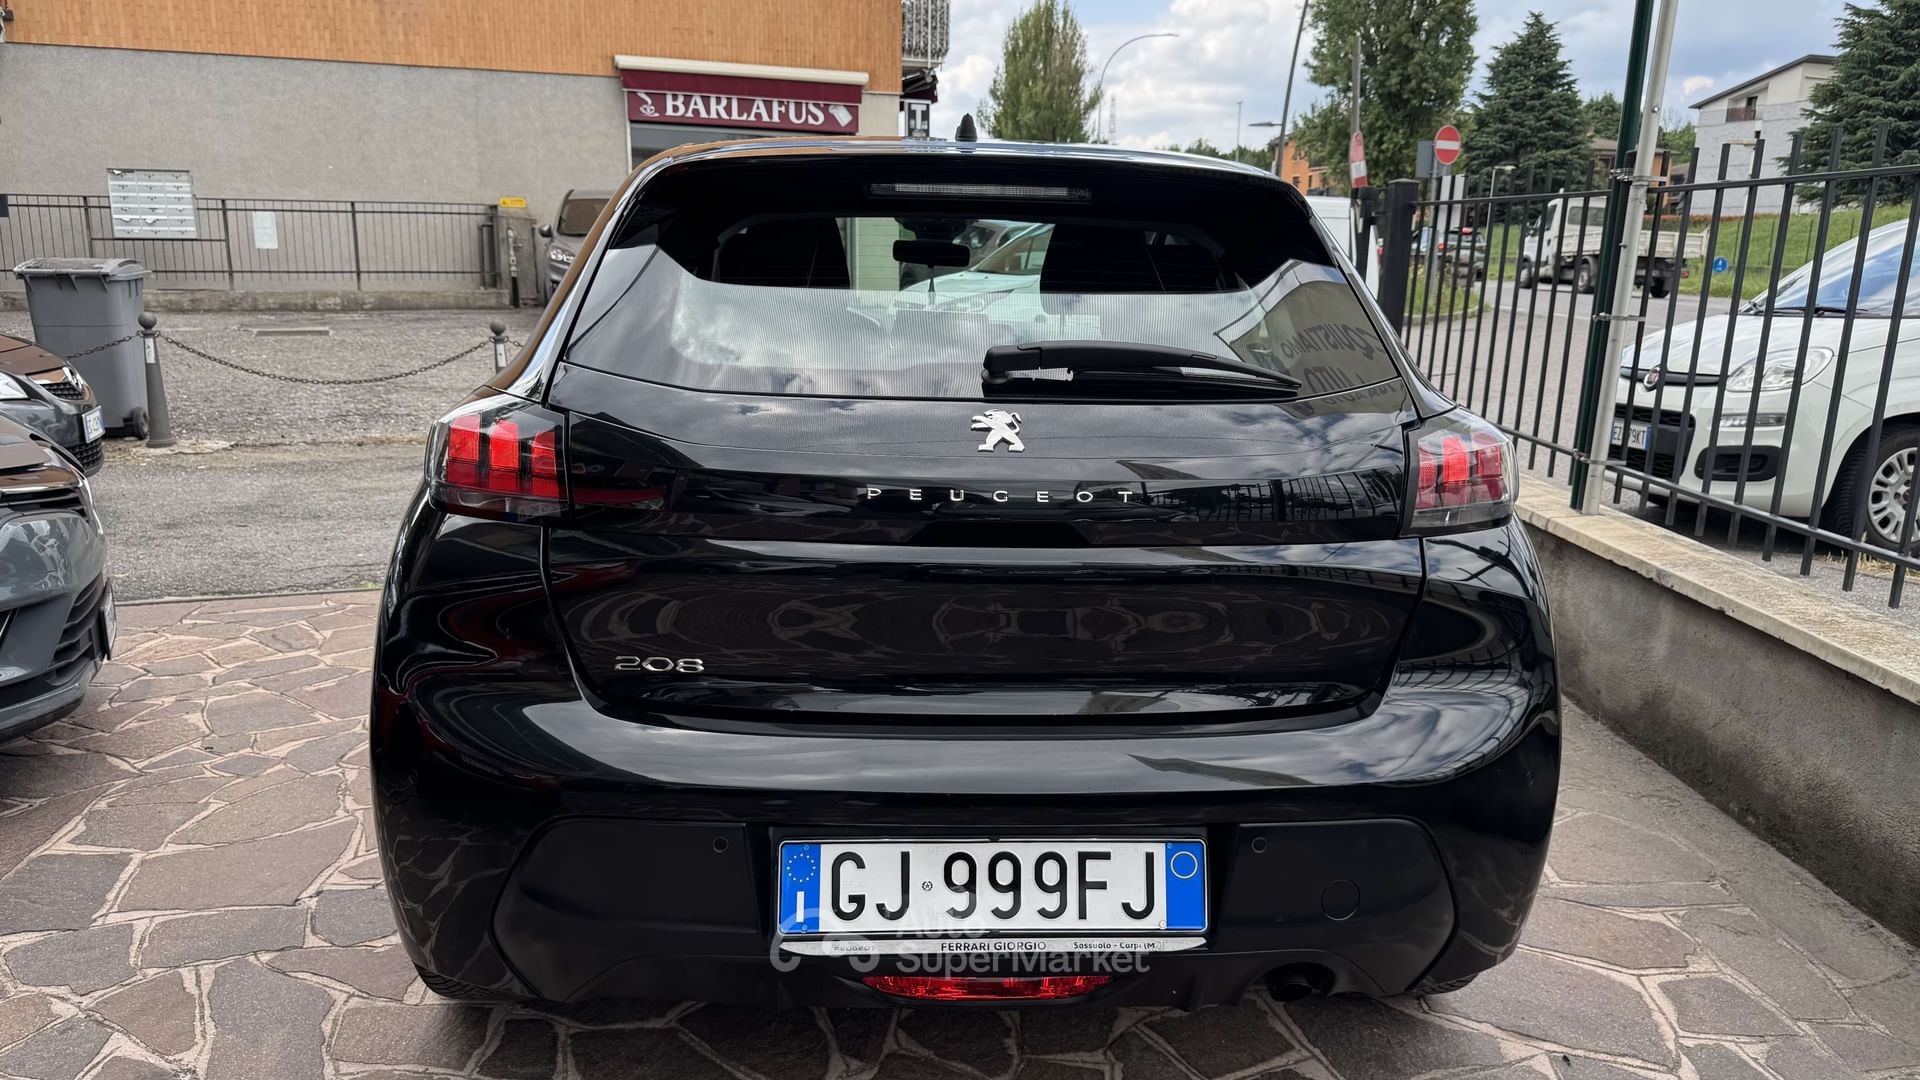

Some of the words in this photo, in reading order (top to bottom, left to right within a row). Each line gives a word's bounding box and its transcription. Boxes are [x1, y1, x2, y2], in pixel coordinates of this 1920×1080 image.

[665, 92, 826, 126] BARLAFUS
[1612, 425, 1646, 445] EZ9KT
[866, 487, 1133, 503] PEUGEOT
[614, 655, 705, 673] 208
[941, 942, 990, 951] FERRARI
[994, 941, 1047, 952] GIORGIO
